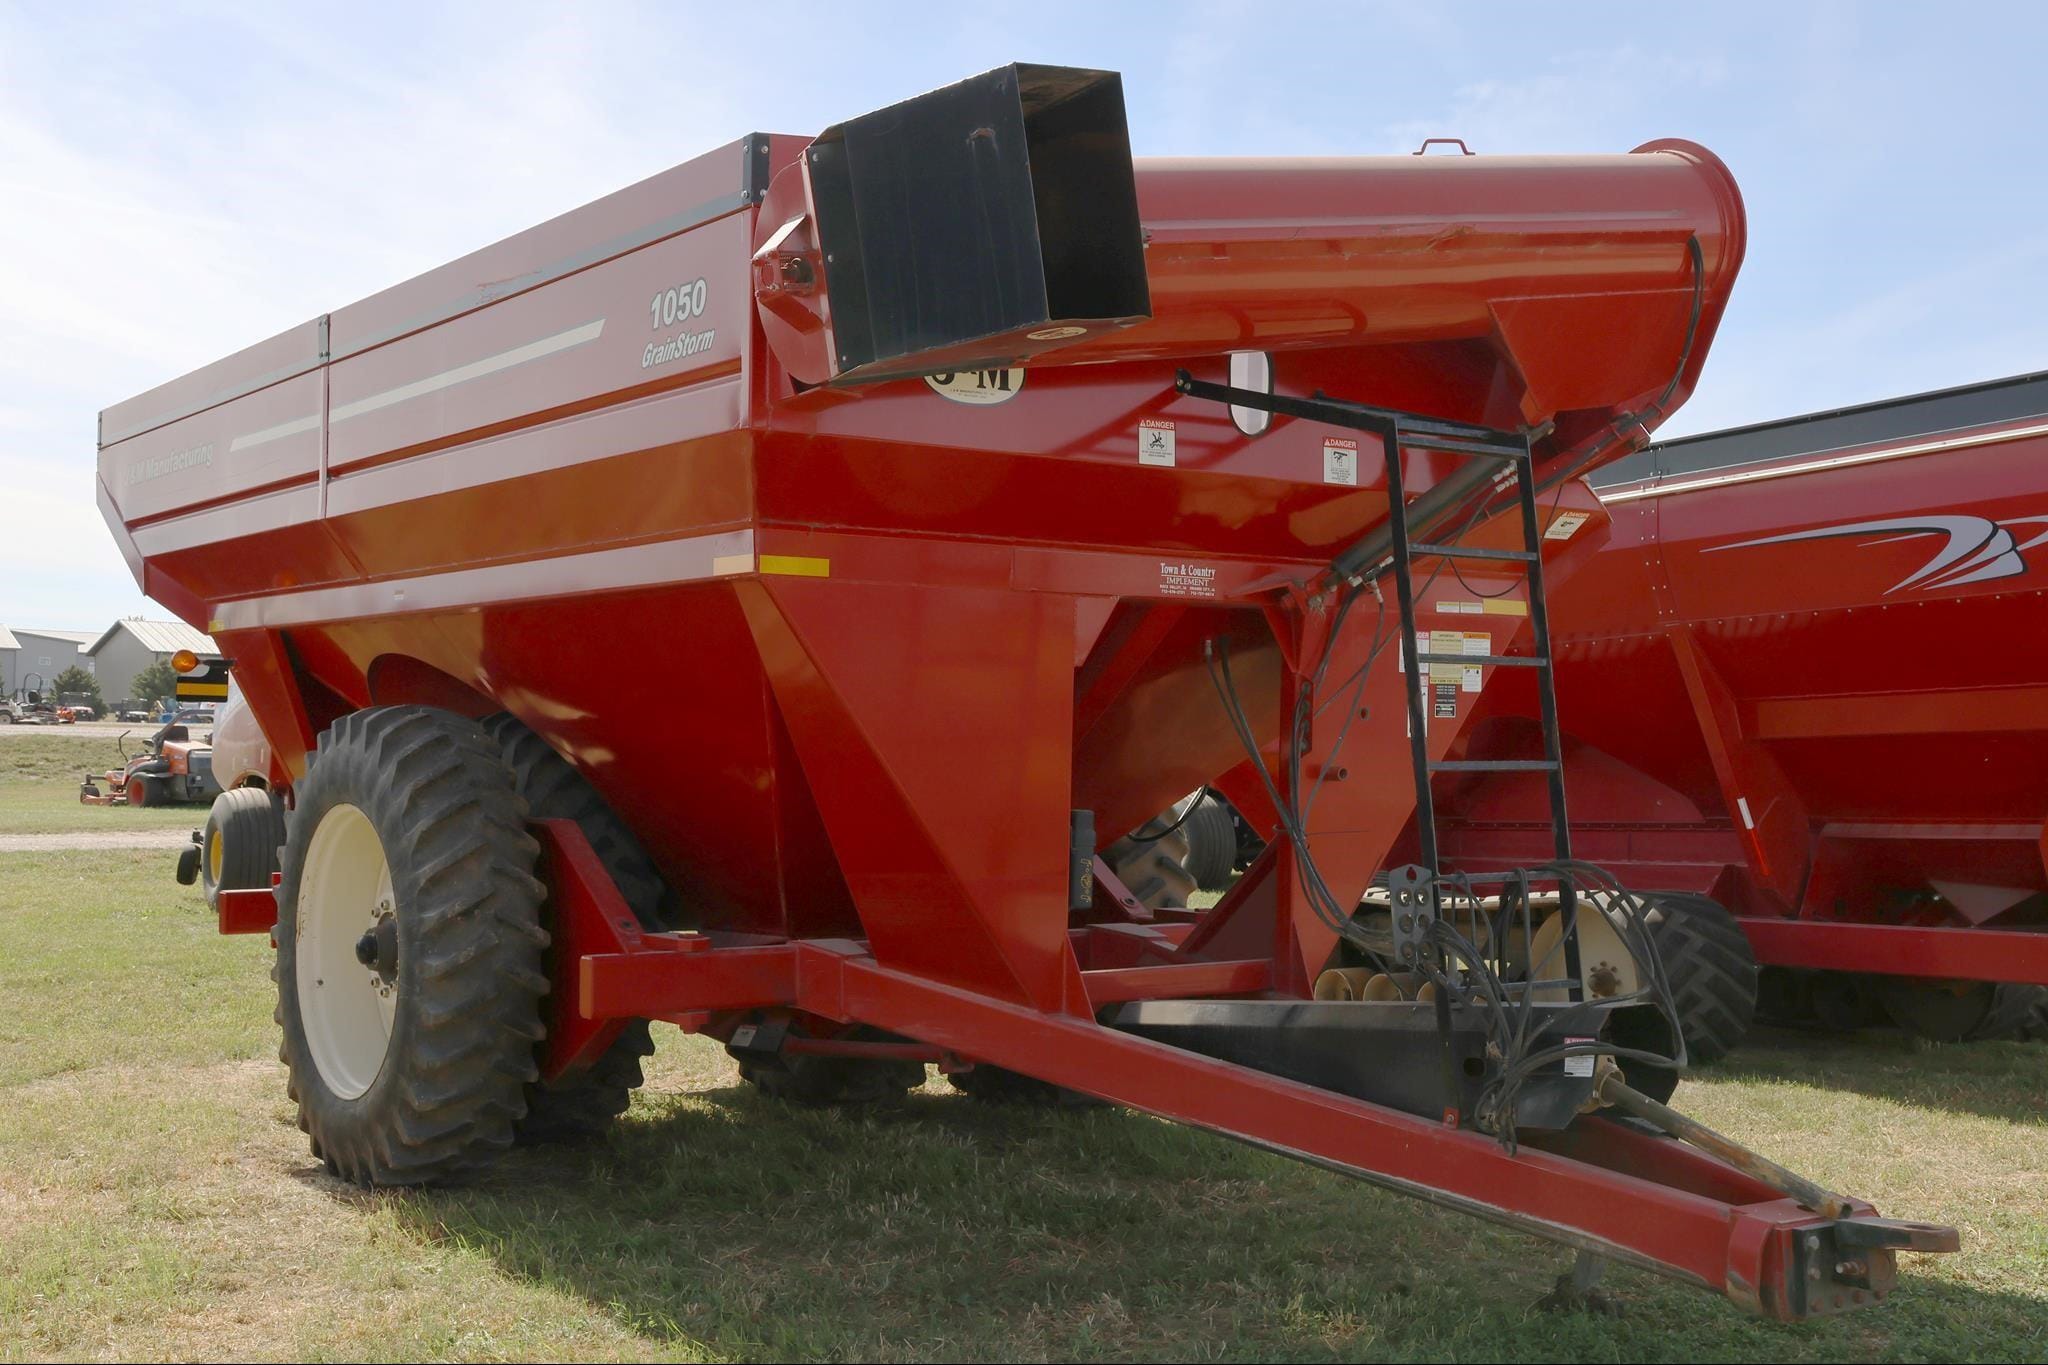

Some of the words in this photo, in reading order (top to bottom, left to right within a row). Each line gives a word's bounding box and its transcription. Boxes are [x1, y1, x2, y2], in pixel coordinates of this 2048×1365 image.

[650, 278, 707, 330] 1050
[641, 329, 715, 369] GrainStorm
[1145, 419, 1175, 430] DANGER
[1330, 438, 1357, 449] DANGER
[1160, 562, 1179, 575] Town
[1180, 564, 1187, 576] &
[1188, 564, 1216, 580] Country
[1166, 577, 1210, 587] IMPLEMENT
